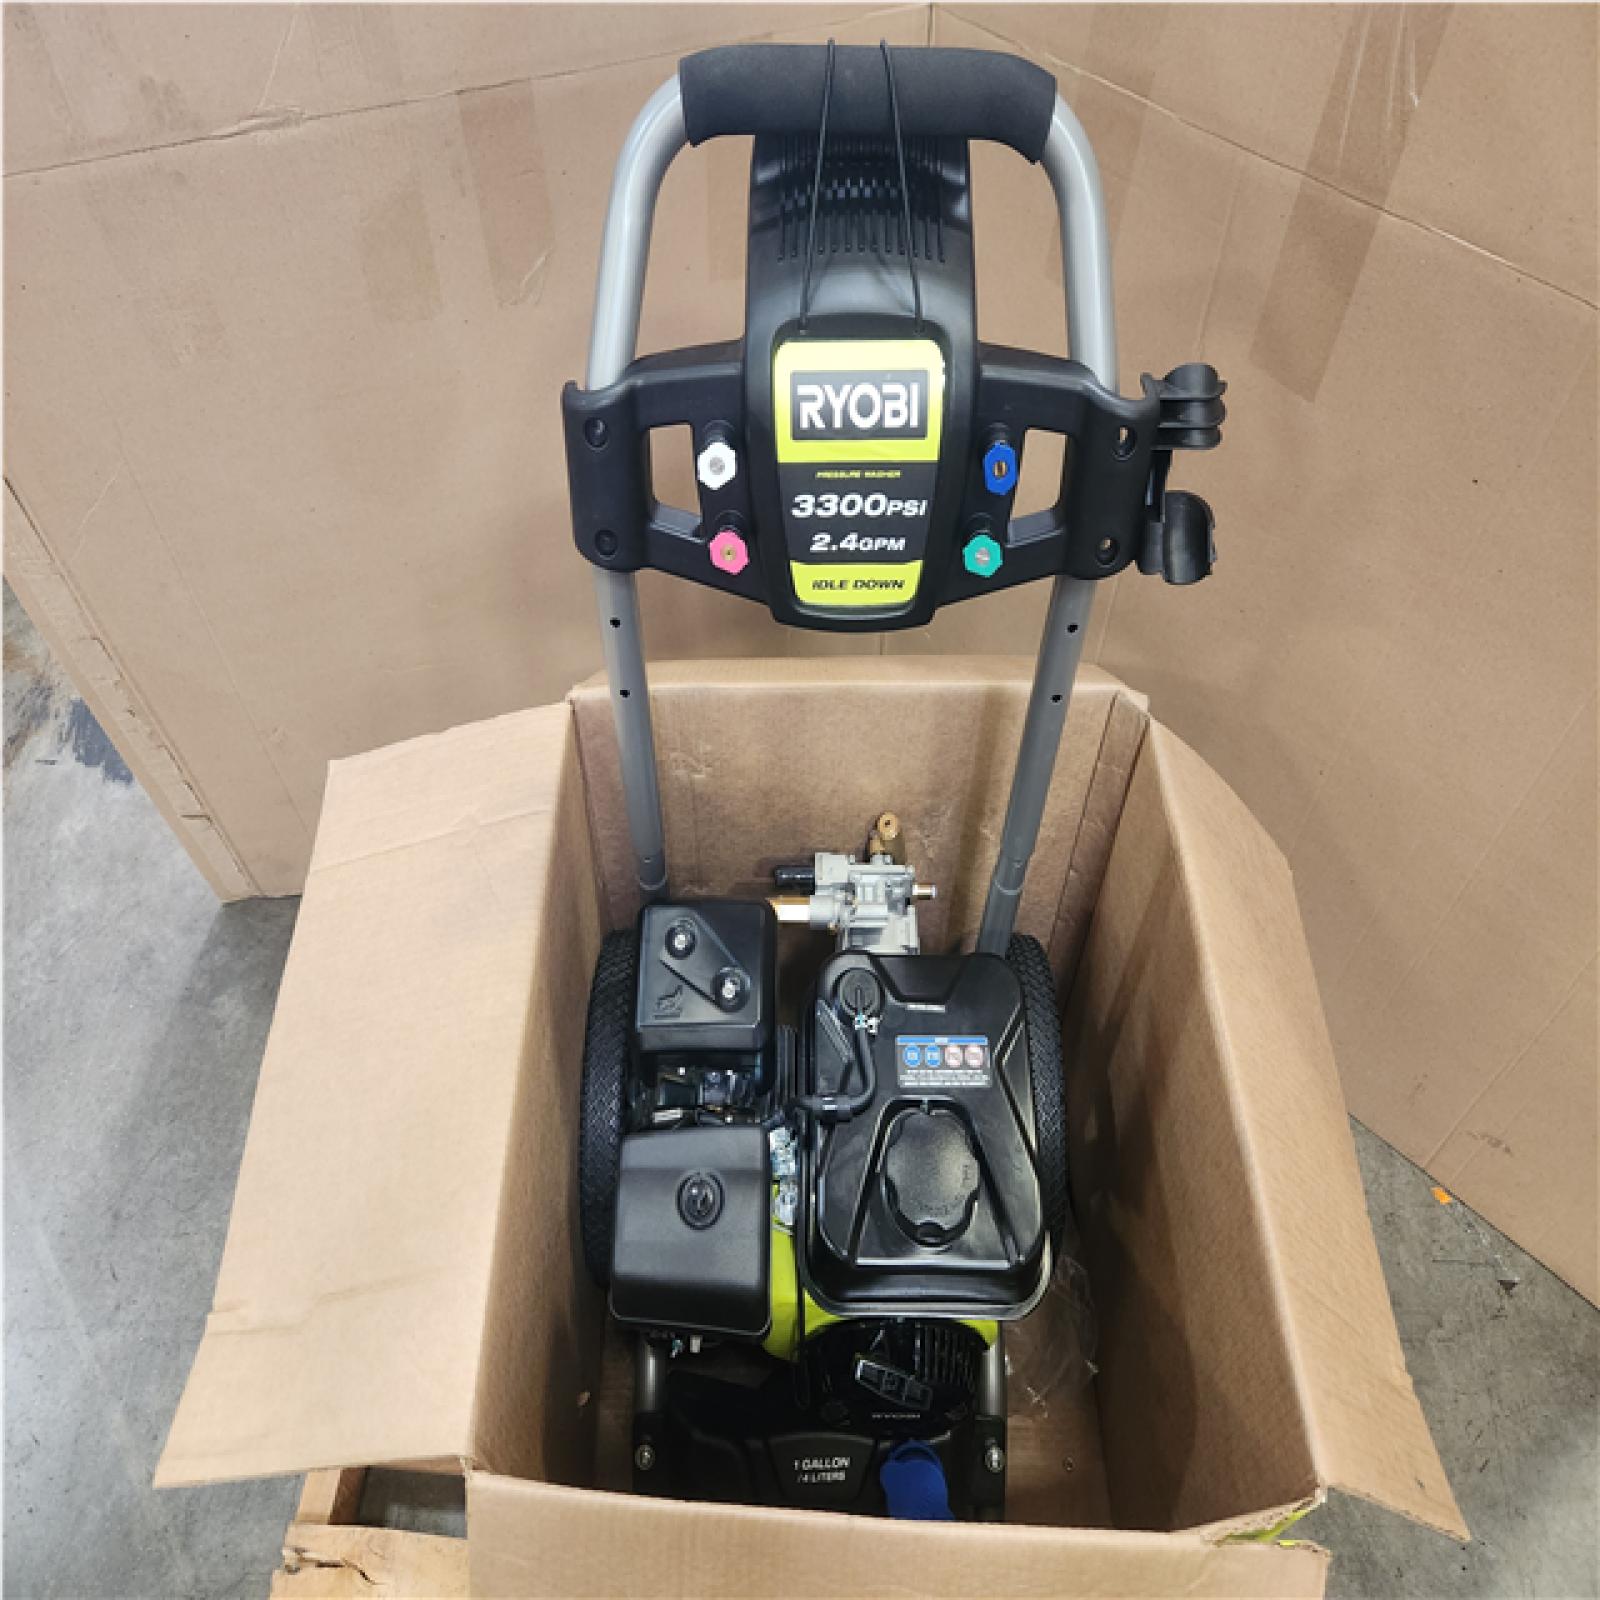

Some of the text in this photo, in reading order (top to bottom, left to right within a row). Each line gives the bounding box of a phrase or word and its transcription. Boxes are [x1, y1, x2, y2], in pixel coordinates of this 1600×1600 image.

[796, 383, 919, 429] RYOBI
[812, 579, 905, 590] IDLE DOWN
[802, 1457, 850, 1470] GALLON
[812, 1470, 845, 1482] LITERS
